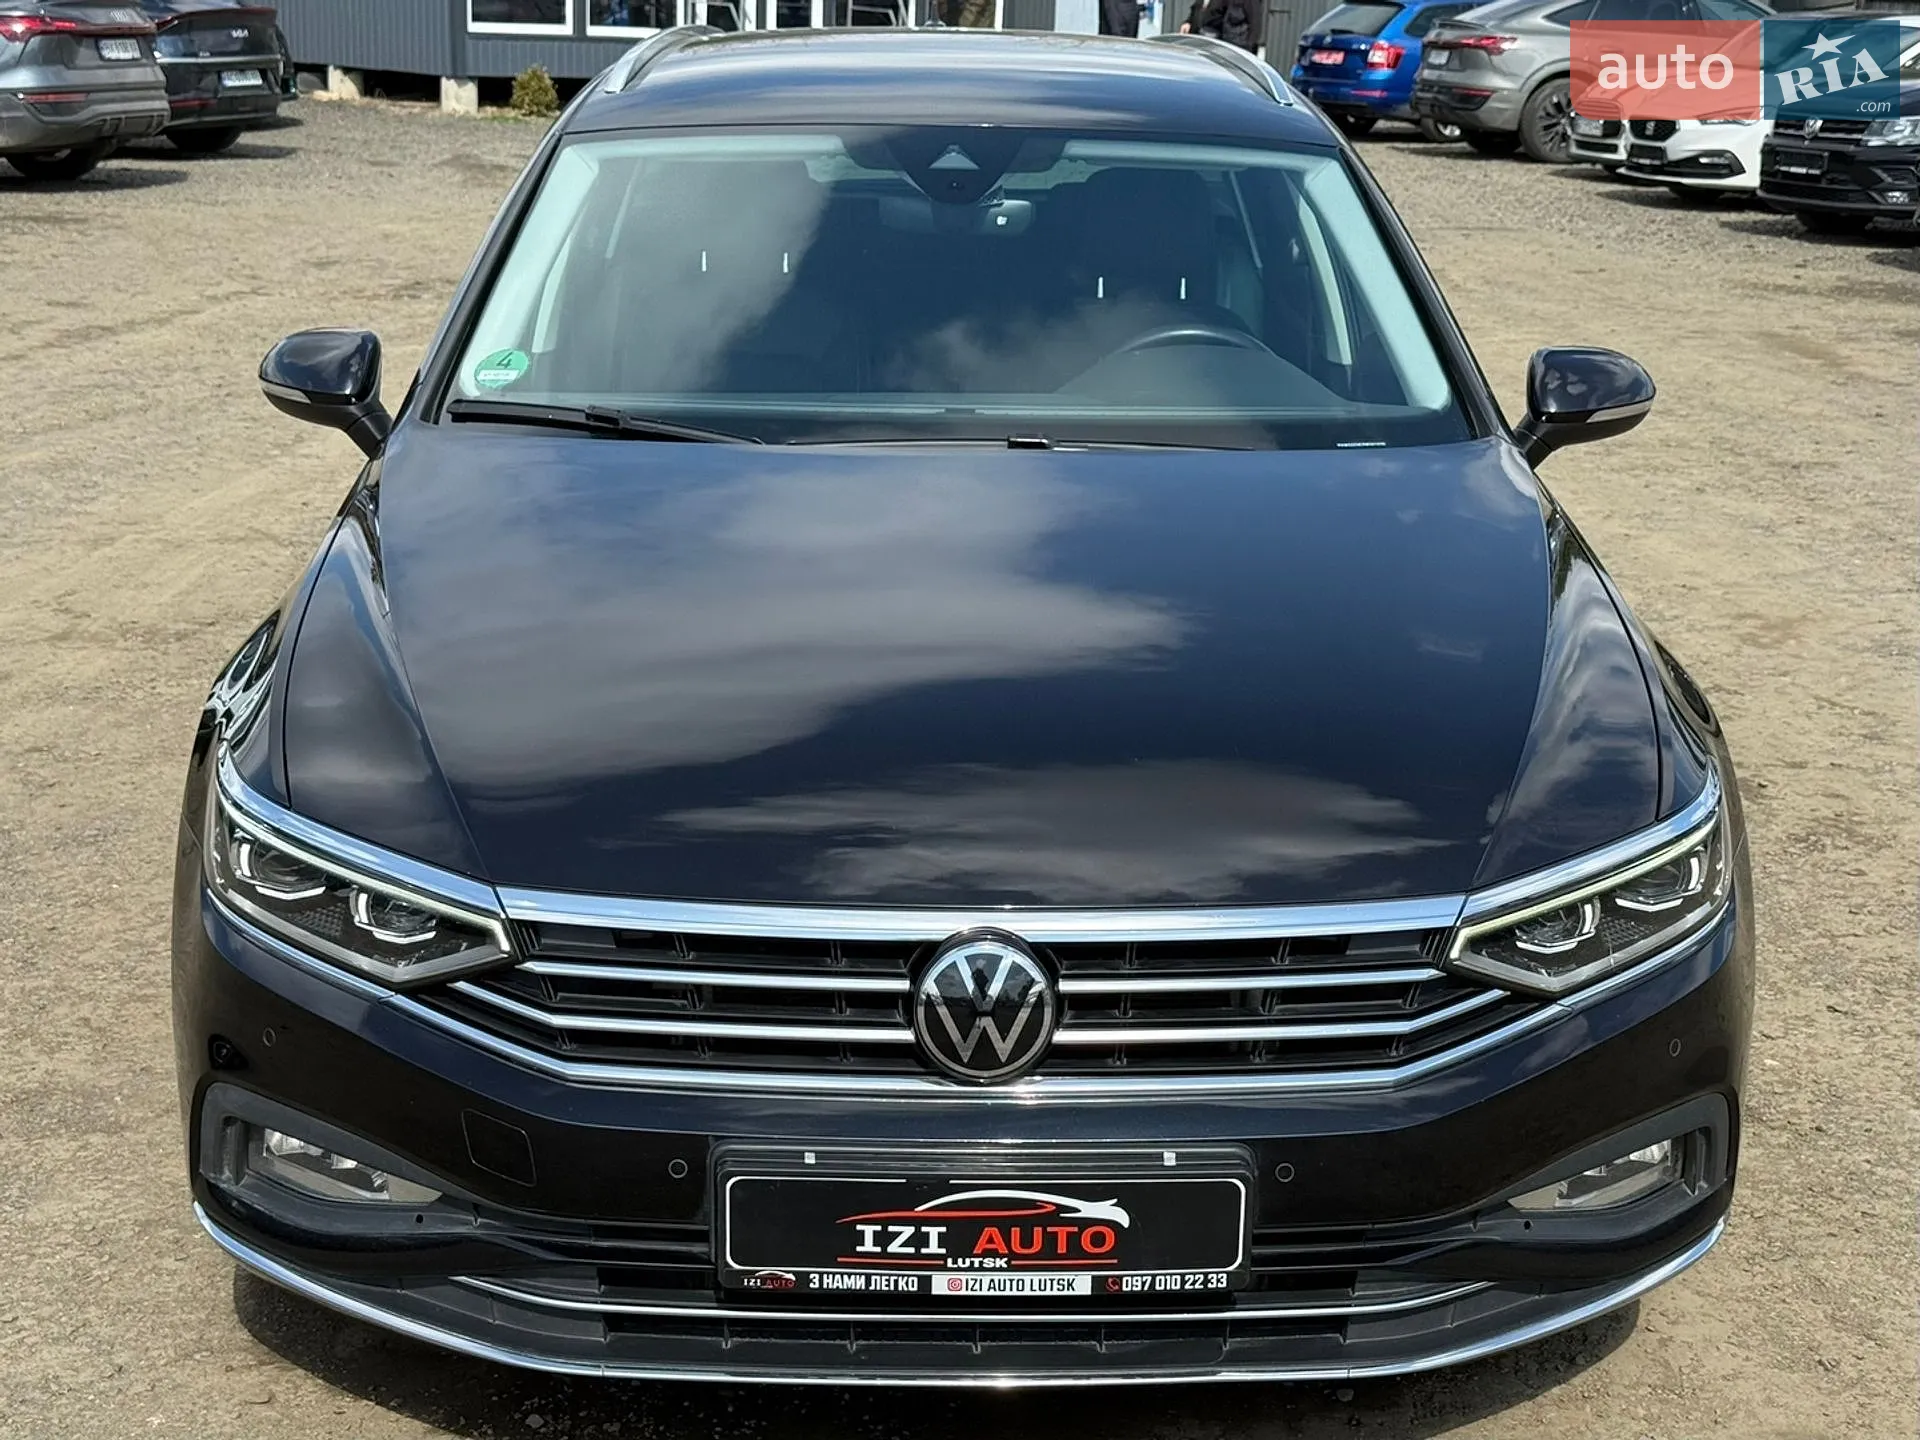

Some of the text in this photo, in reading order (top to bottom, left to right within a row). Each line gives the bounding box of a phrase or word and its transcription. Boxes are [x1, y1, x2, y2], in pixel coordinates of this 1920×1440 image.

[495, 351, 513, 369] 4
[855, 1224, 1115, 1254] IZI AUTO
[946, 1257, 1009, 1268] LUTSK
[822, 1274, 865, 1290] НАМИ
[868, 1275, 918, 1291] ЛЕГКО
[965, 1278, 1076, 1292] IZI AUTO LUTSK
[1122, 1273, 1227, 1291] 097 010 22 33
